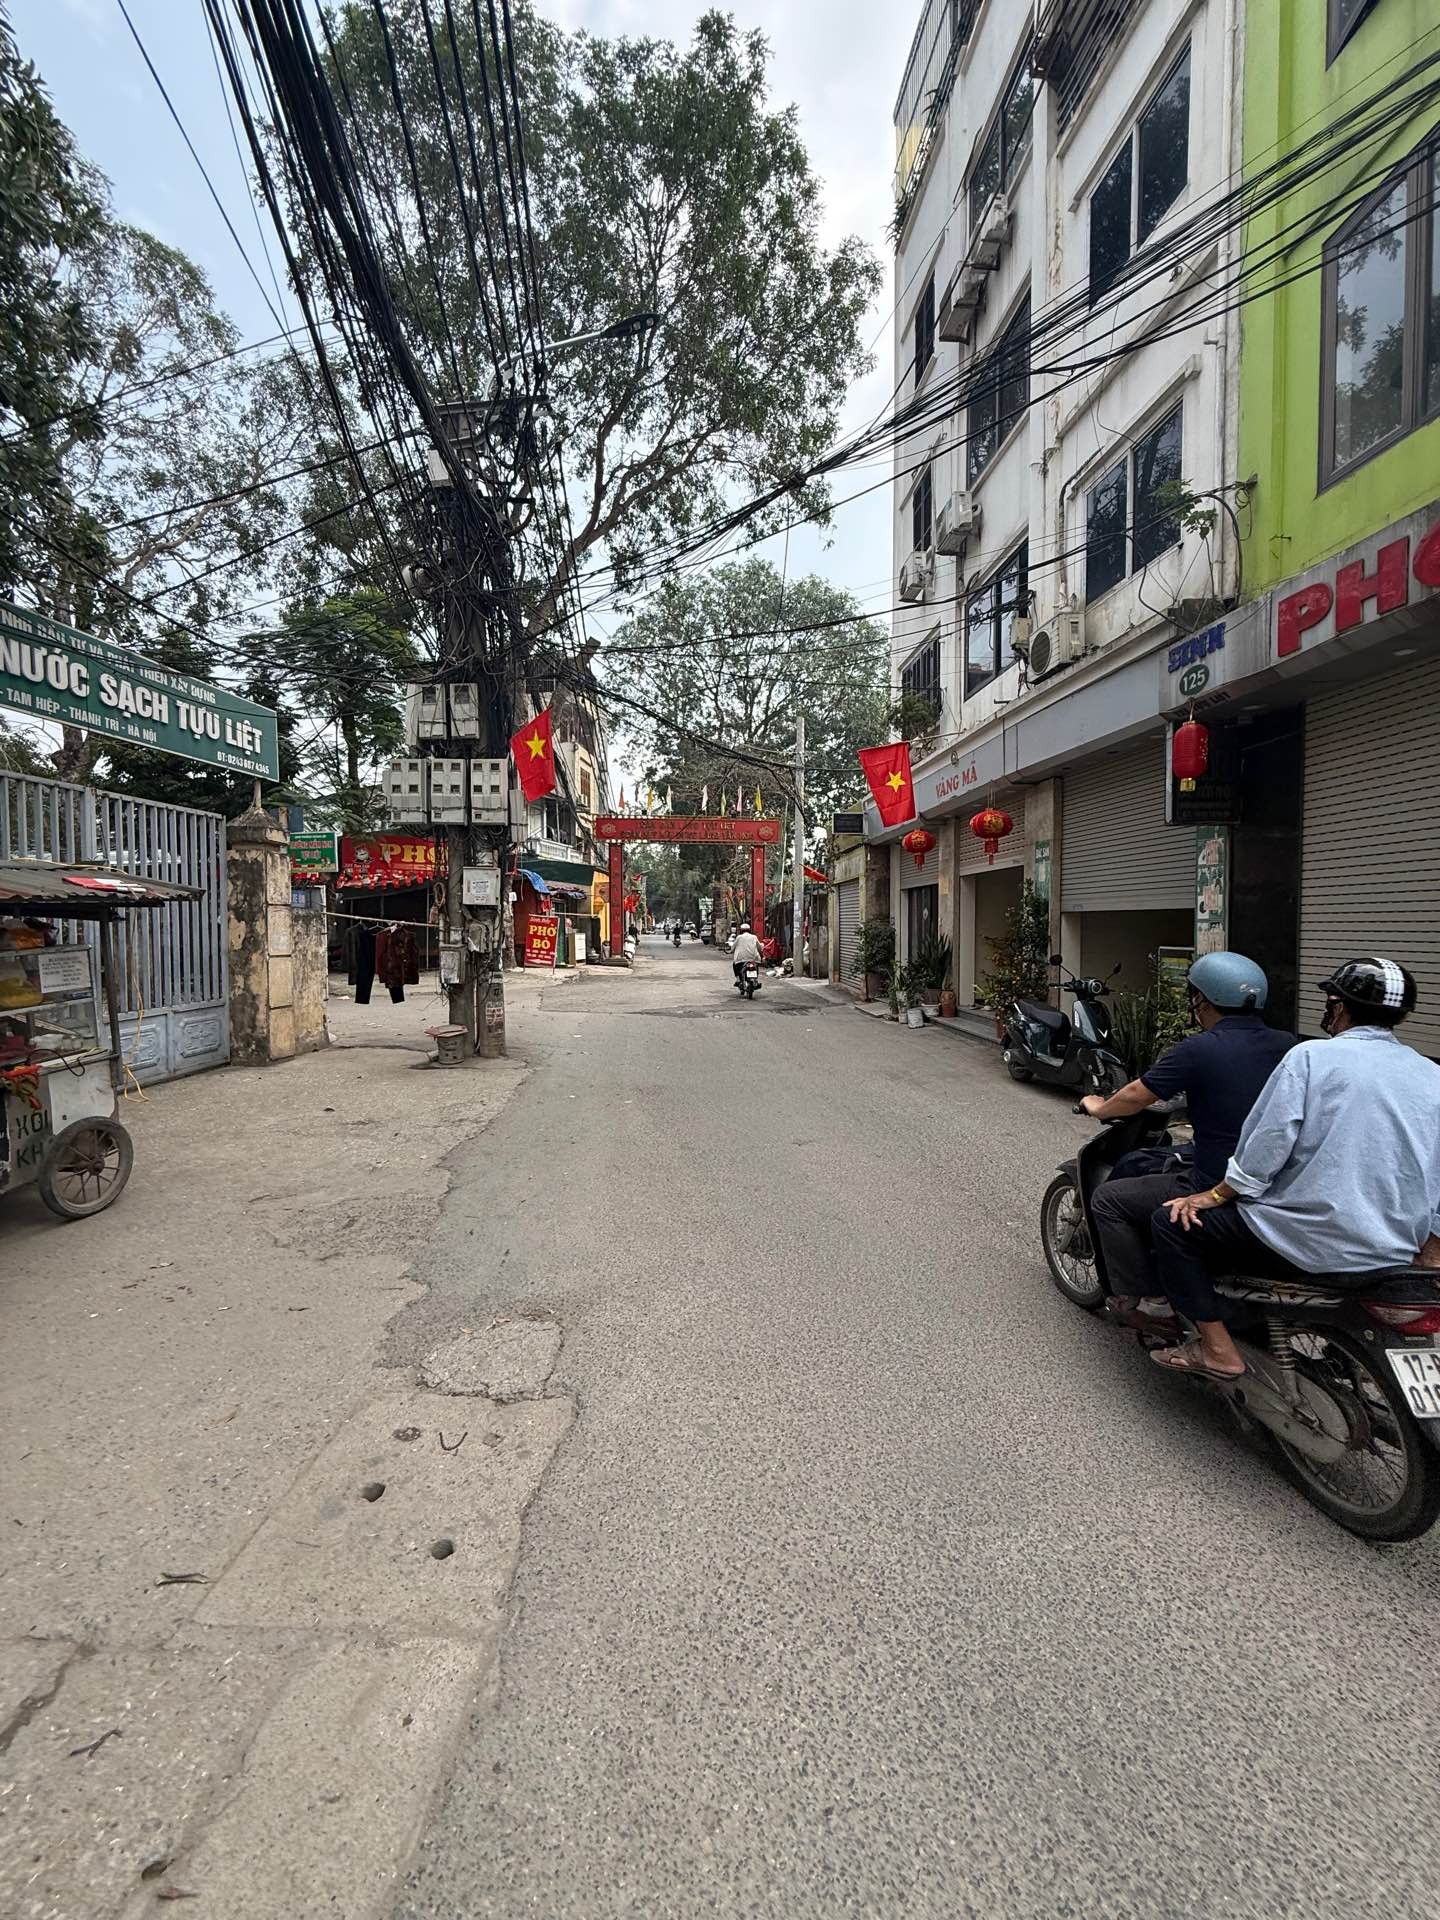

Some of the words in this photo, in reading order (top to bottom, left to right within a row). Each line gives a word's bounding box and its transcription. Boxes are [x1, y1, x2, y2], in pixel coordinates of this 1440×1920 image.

[0, 634, 90, 698] NƯỚC
[99, 672, 169, 724] SẠCH
[176, 699, 221, 741] TỰU
[225, 717, 263, 756] LIỆT
[1182, 668, 1207, 693] 125
[7, 687, 32, 707] TAM
[35, 696, 61, 715] HIỆP
[70, 706, 102, 727] THANH
[105, 716, 120, 732] TRÌ
[127, 721, 140, 738] HÀ
[142, 727, 157, 744] NỘI
